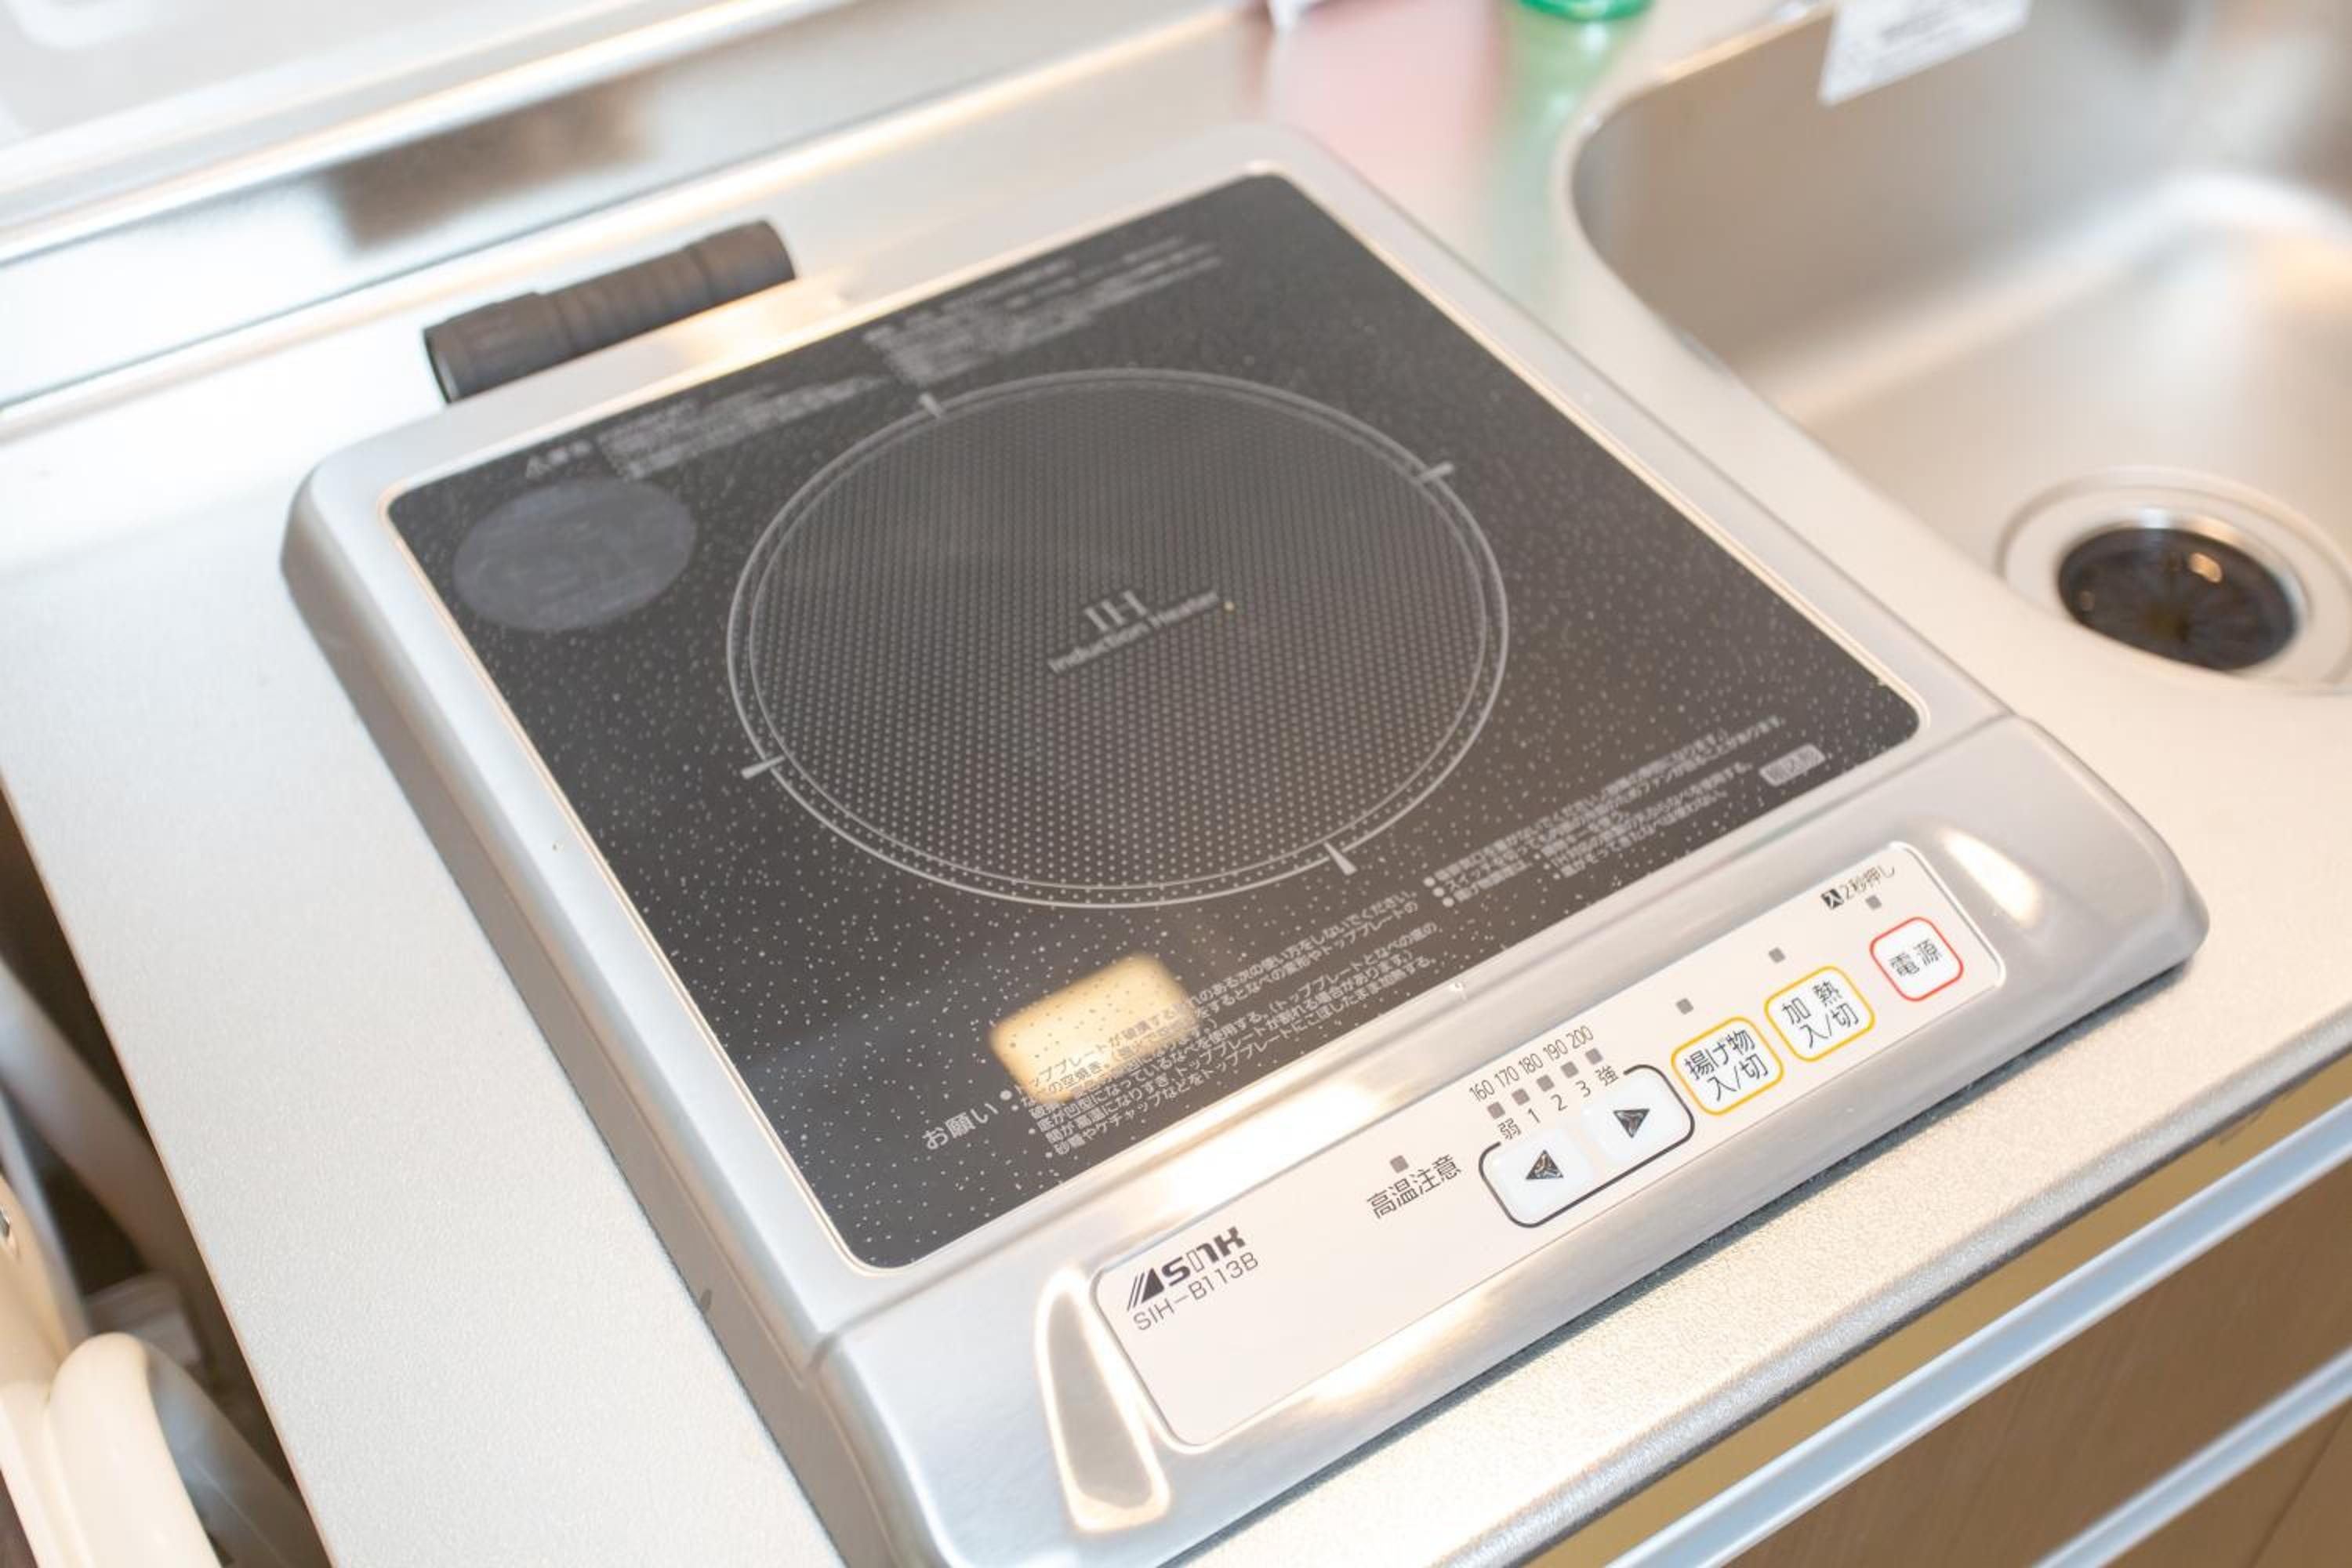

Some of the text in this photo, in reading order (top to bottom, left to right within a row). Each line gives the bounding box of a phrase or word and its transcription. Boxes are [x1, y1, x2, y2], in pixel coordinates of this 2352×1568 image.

[1084, 590, 1147, 632] IH
[1799, 1002, 1860, 1049] 入/切
[1468, 1025, 1594, 1102] 160 170 180 190 200
[1684, 1029, 1755, 1081] 揚げ物
[1706, 1053, 1769, 1102] 入/切
[918, 1098, 1003, 1152] お願い
[1497, 1065, 1619, 1141] 弱 1 2 3 強
[1367, 1154, 1462, 1219] 高温注意
[1133, 1251, 1259, 1330] SIH-B113B
